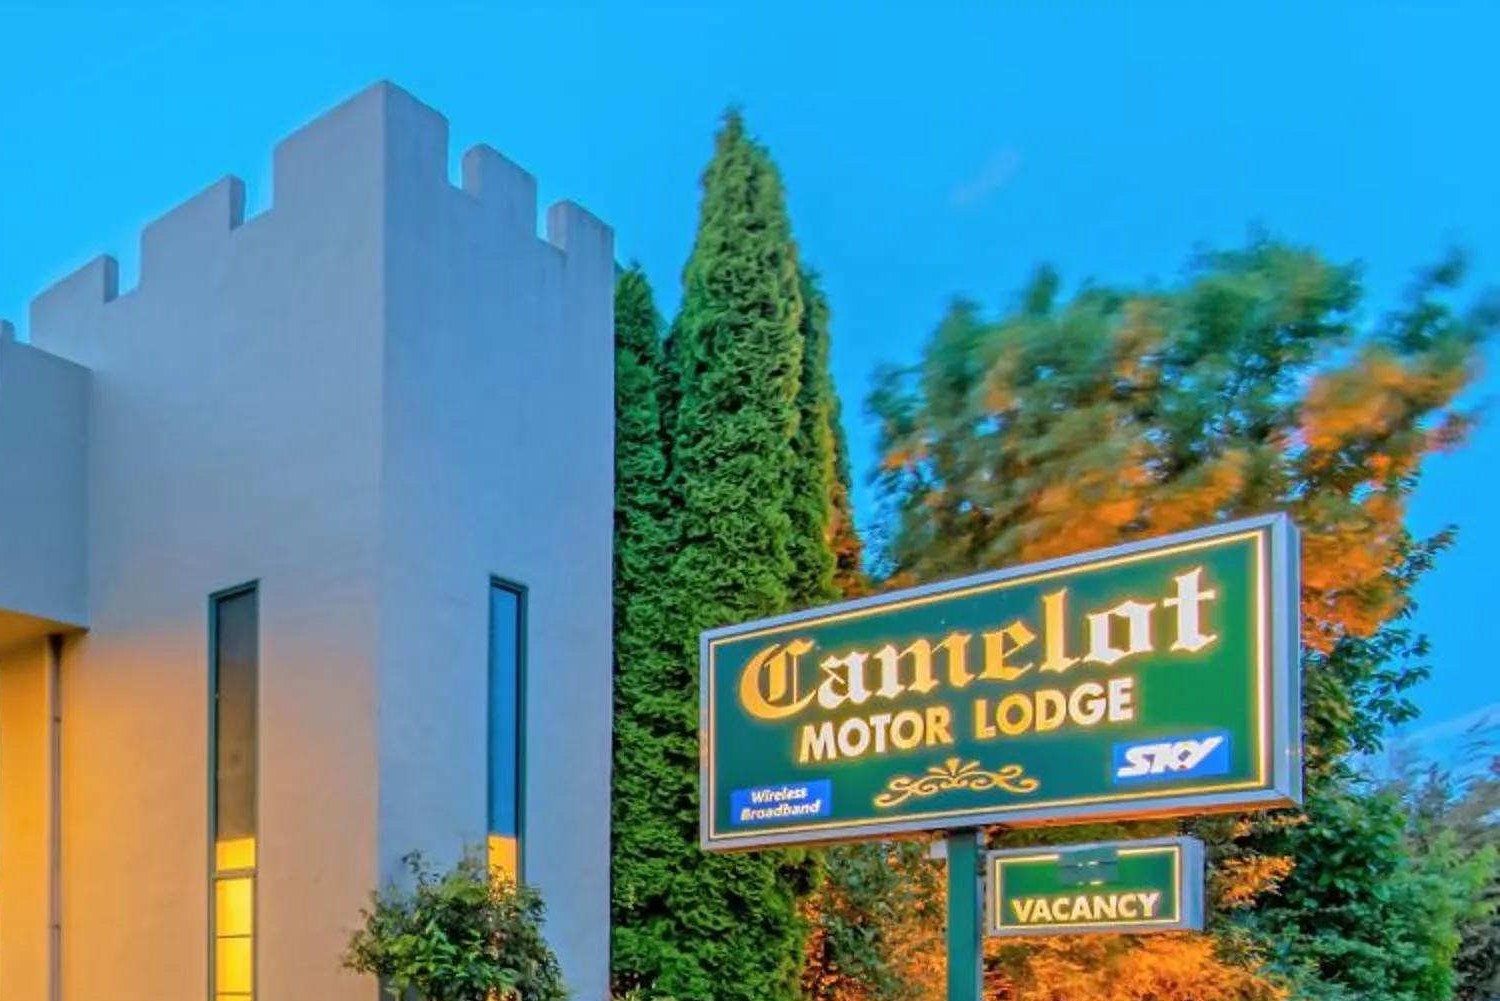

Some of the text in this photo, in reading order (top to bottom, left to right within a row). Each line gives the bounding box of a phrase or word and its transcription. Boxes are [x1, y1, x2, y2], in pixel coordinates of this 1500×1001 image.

[739, 565, 1218, 720] Camelot
[799, 678, 1135, 763] MOTOR LODGE
[1117, 736, 1223, 777] SKY
[740, 799, 821, 821] Broadband
[751, 787, 808, 803] Wireless
[1012, 891, 1161, 923] VACANCY
